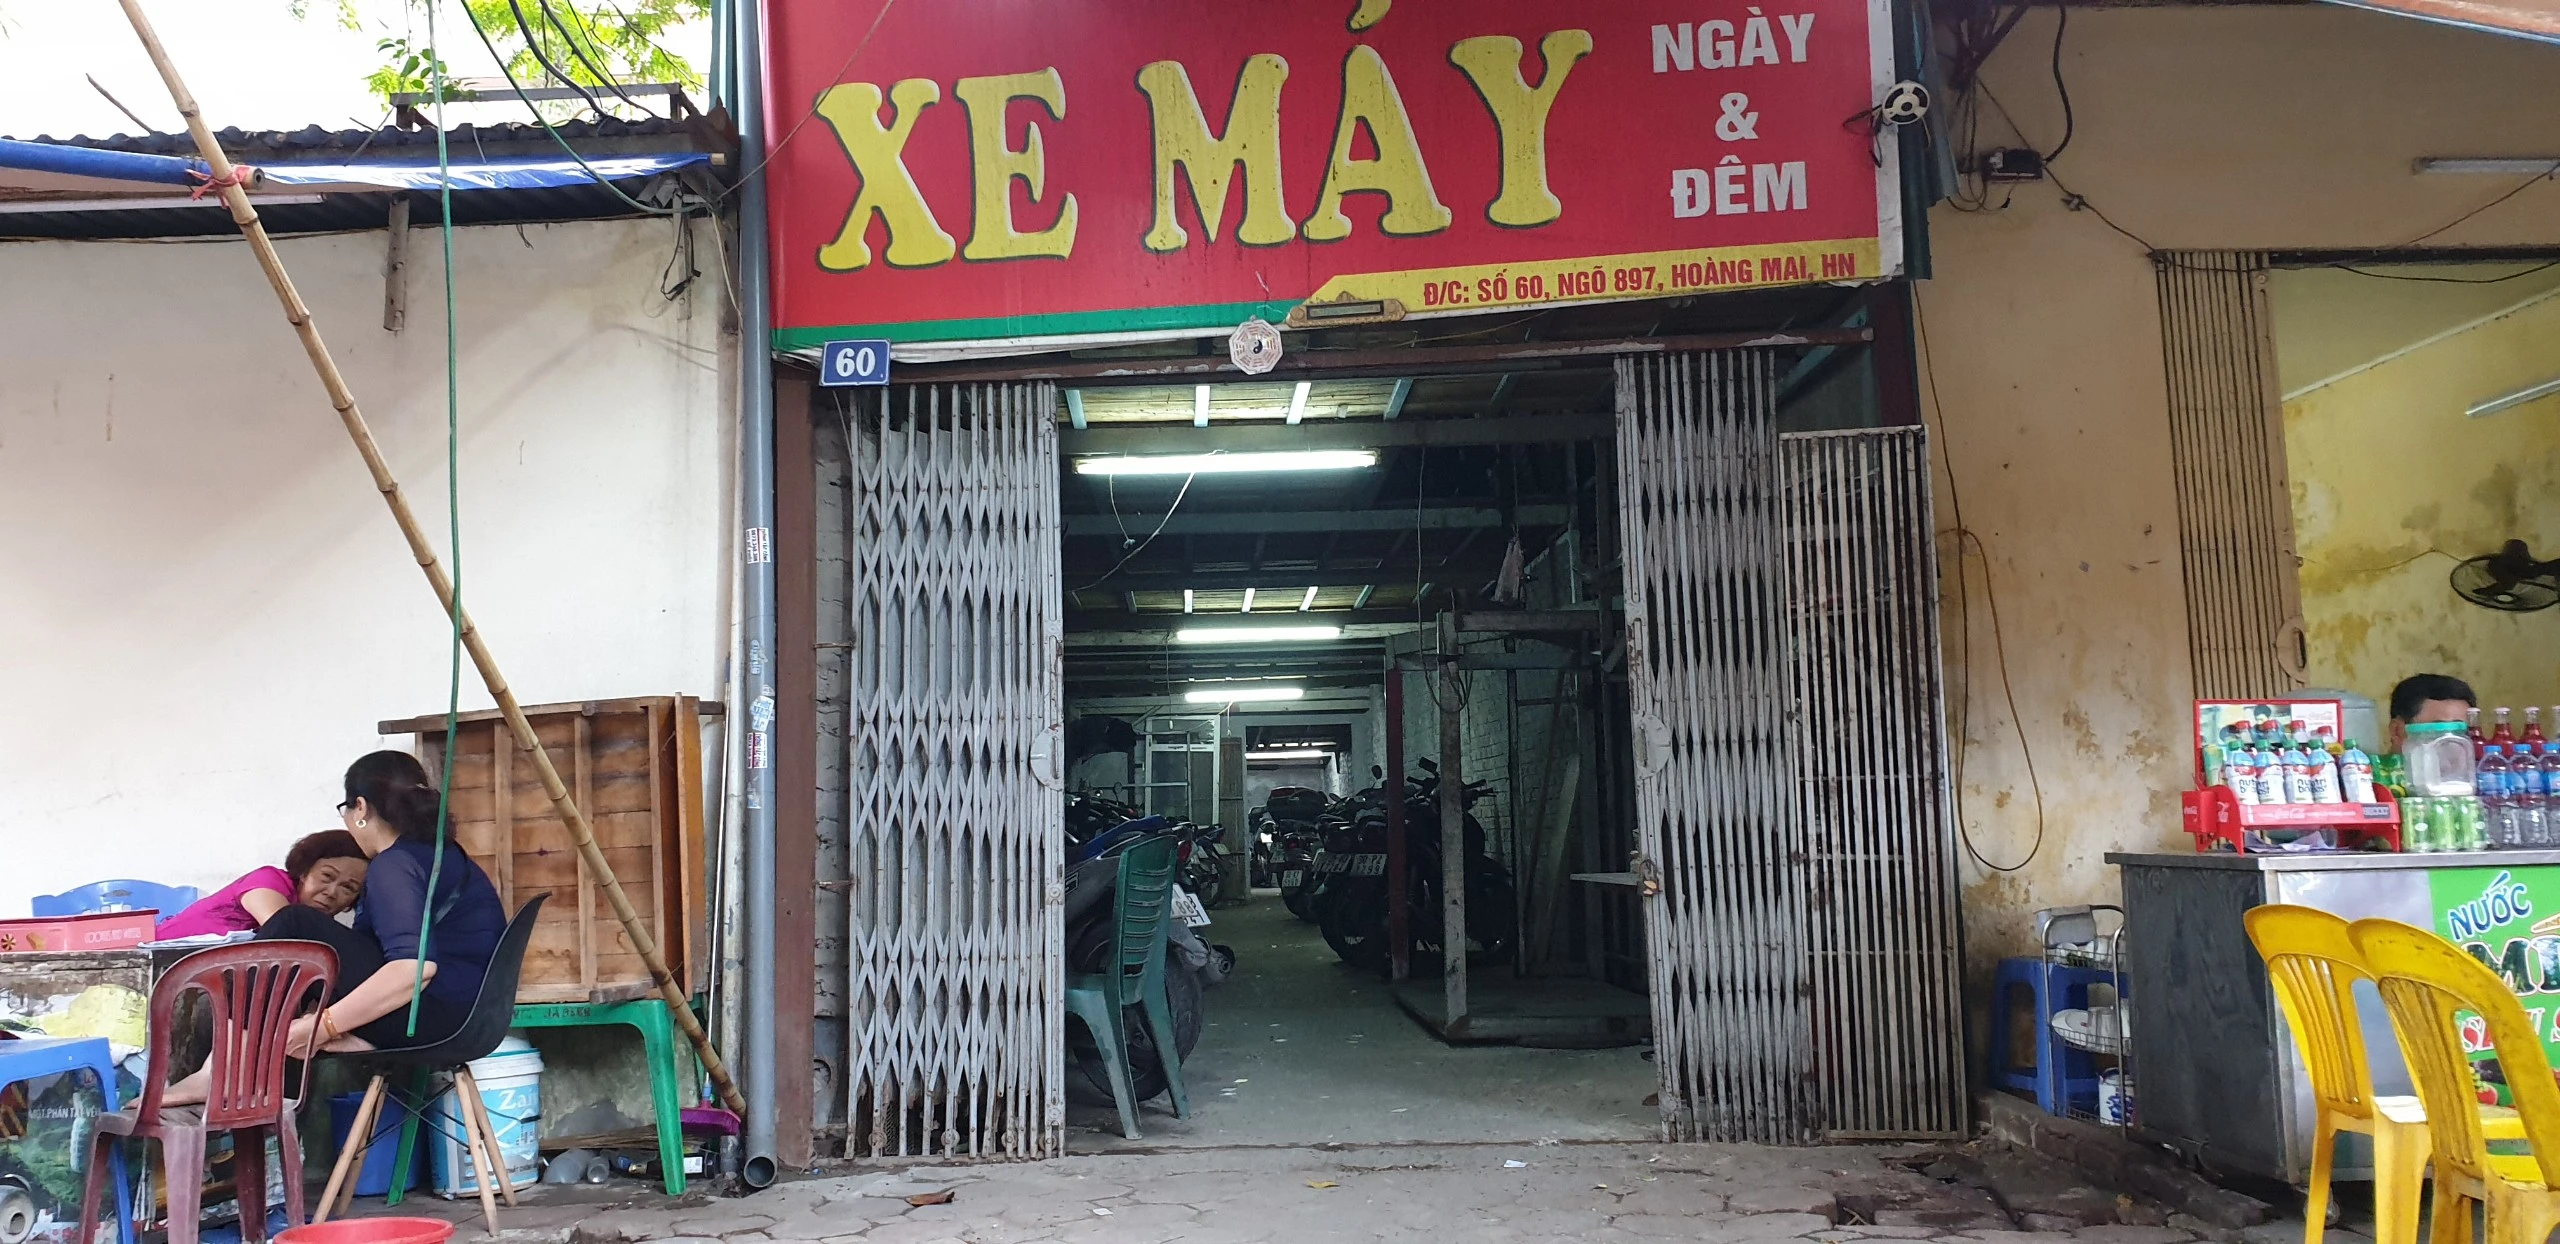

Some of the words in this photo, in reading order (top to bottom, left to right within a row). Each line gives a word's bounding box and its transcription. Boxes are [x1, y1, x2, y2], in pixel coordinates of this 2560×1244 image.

[1651, 6, 1816, 74] NGÀY
[815, 66, 1079, 272] XE
[1135, 0, 1594, 254] MÁY
[1714, 92, 1759, 141] &
[1670, 154, 1808, 219] ĐÊM
[1424, 280, 1470, 306] Đ/C:
[1477, 267, 1508, 303] SỐ
[1515, 275, 1550, 301] 60,
[1558, 266, 1606, 297] NGÕ
[1614, 267, 1663, 293] 897,
[1671, 256, 1752, 290] HOÀNG
[1760, 256, 1814, 283] MAI,
[1821, 253, 1856, 278] HN
[836, 347, 876, 377] 60
[2448, 871, 2532, 940] NƯỚC
